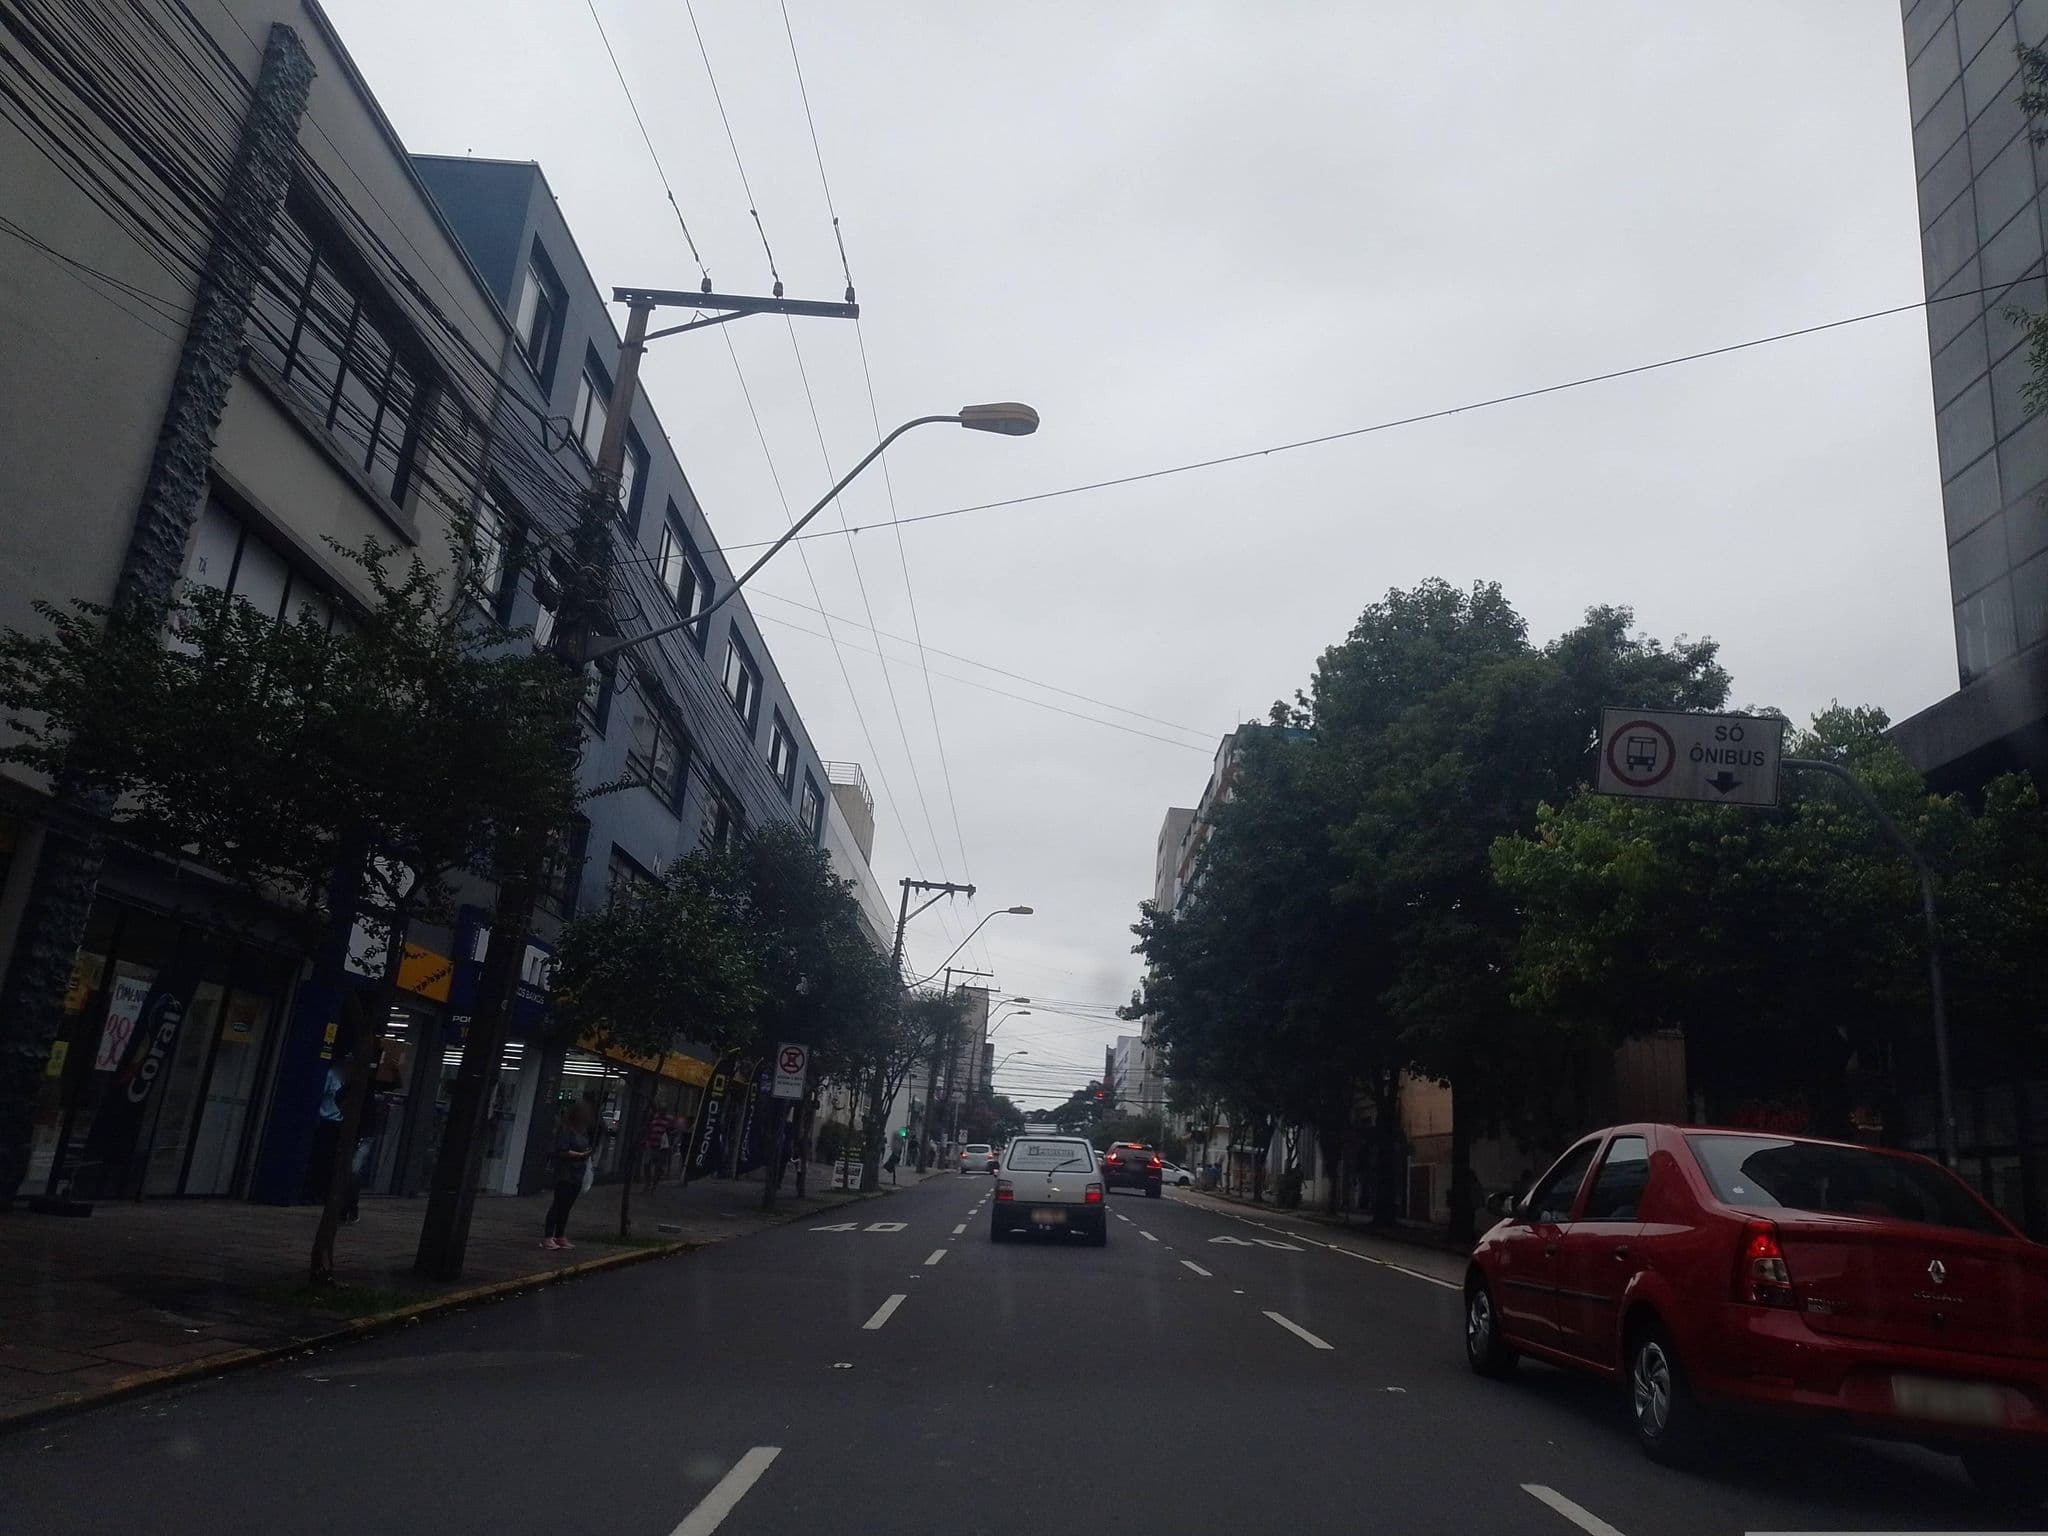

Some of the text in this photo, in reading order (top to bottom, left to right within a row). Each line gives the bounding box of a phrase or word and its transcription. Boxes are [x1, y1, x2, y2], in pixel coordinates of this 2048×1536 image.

[1714, 723, 1744, 742] SÓ
[1690, 743, 1764, 766] ÔNIBUS
[128, 1011, 181, 1103] Coral
[808, 1222, 908, 1232] 40
